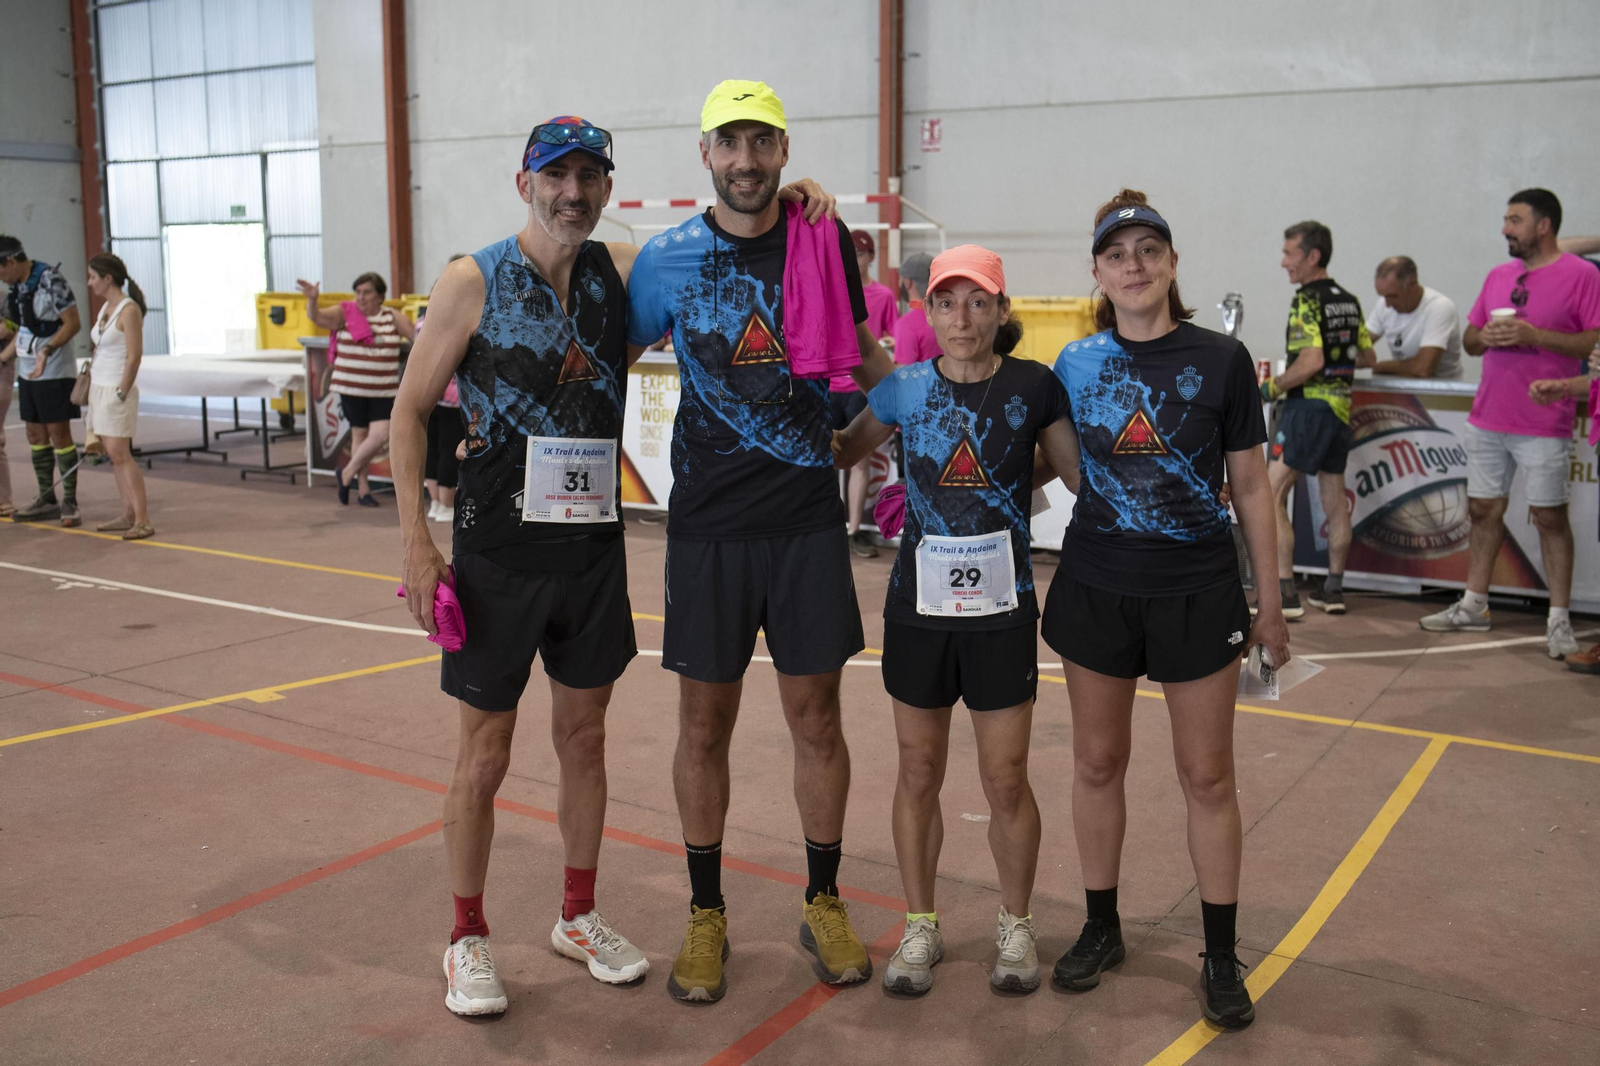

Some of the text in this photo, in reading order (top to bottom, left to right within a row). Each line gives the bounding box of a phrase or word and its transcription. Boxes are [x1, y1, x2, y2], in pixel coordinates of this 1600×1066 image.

[640, 373, 680, 391] EXPLO
[640, 391, 665, 407] THE
[640, 408, 675, 424] WORL
[640, 424, 664, 441] SINCE
[543, 447, 606, 456] IX Trail & Andaina
[640, 441, 660, 458] 1890
[564, 471, 590, 492] 31
[939, 546, 957, 554] Trail
[957, 546, 965, 554] &
[966, 543, 997, 554] Andaina
[928, 553, 957, 561] Montes
[949, 567, 981, 588] 29
